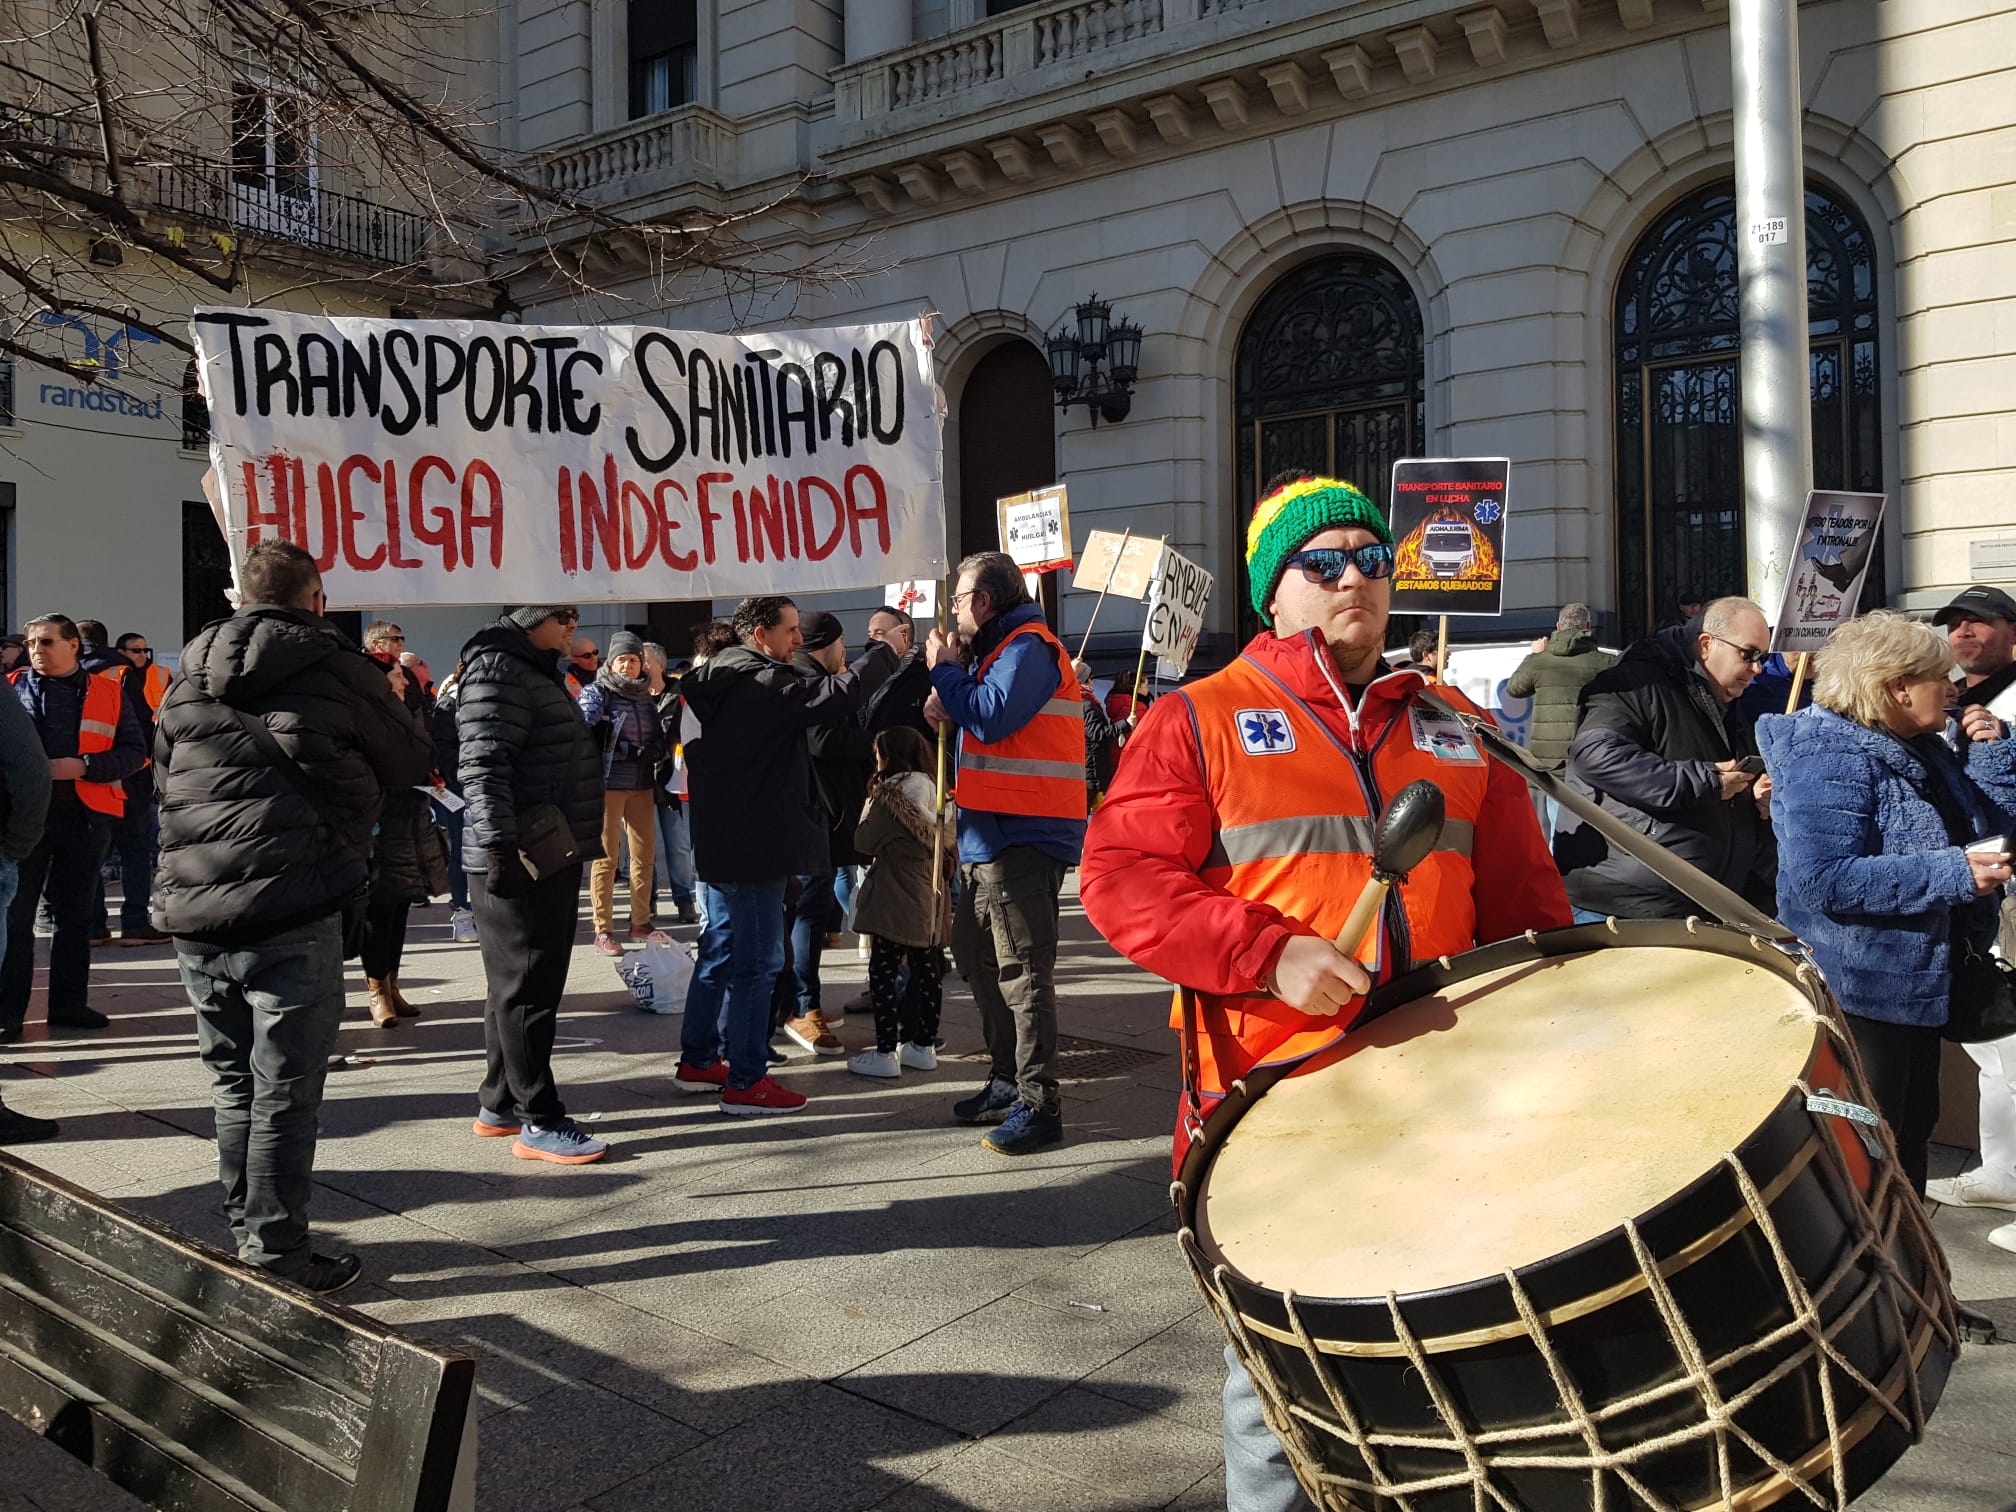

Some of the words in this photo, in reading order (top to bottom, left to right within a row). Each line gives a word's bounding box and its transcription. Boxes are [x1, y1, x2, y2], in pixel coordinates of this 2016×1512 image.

[1758, 232, 1776, 243] 017
[40, 384, 161, 420] randstad
[195, 313, 602, 435] TRANSPORTE
[626, 333, 904, 473] SANITARIO
[1397, 483, 1454, 491] TRANSPORTE
[1455, 481, 1503, 490] SANITARIO
[1426, 494, 1438, 503] EN
[1440, 493, 1470, 503] LUCHA
[242, 453, 503, 573] HUELGA
[558, 453, 891, 576] INDEFINIDA
[1149, 603, 1182, 651] EN
